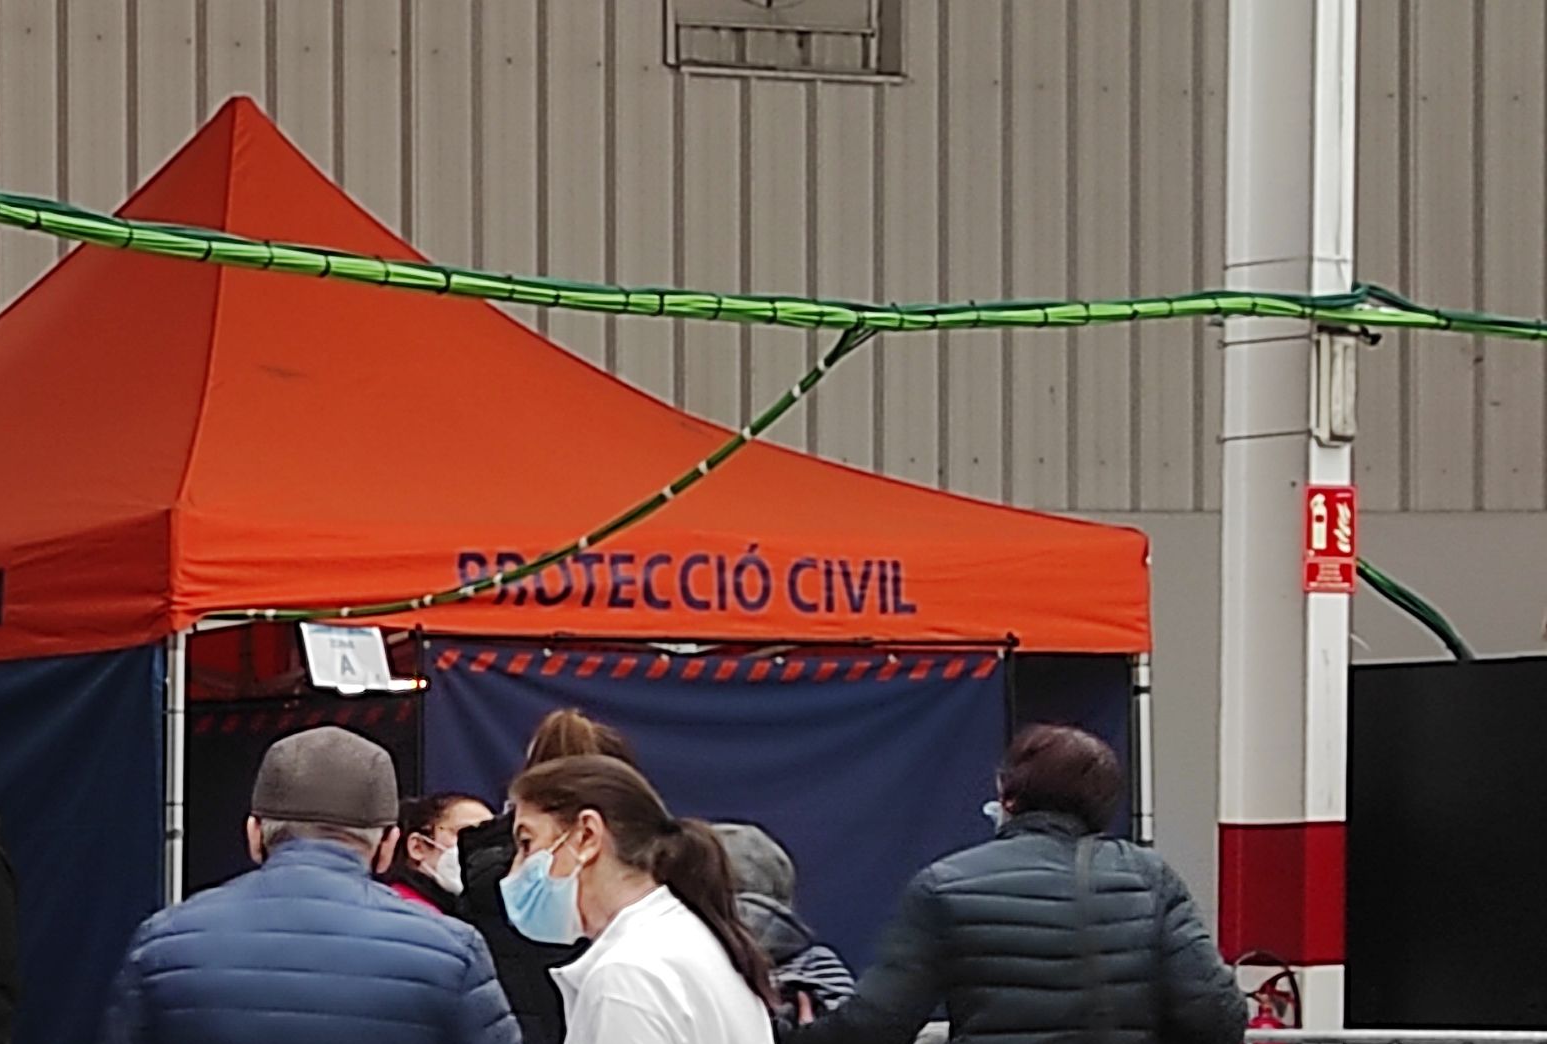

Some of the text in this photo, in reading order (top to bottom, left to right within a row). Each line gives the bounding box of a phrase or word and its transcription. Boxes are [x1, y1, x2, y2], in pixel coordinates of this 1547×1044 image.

[458, 543, 917, 614] PROTECCIÓ CIVIL
[341, 654, 356, 676] A
